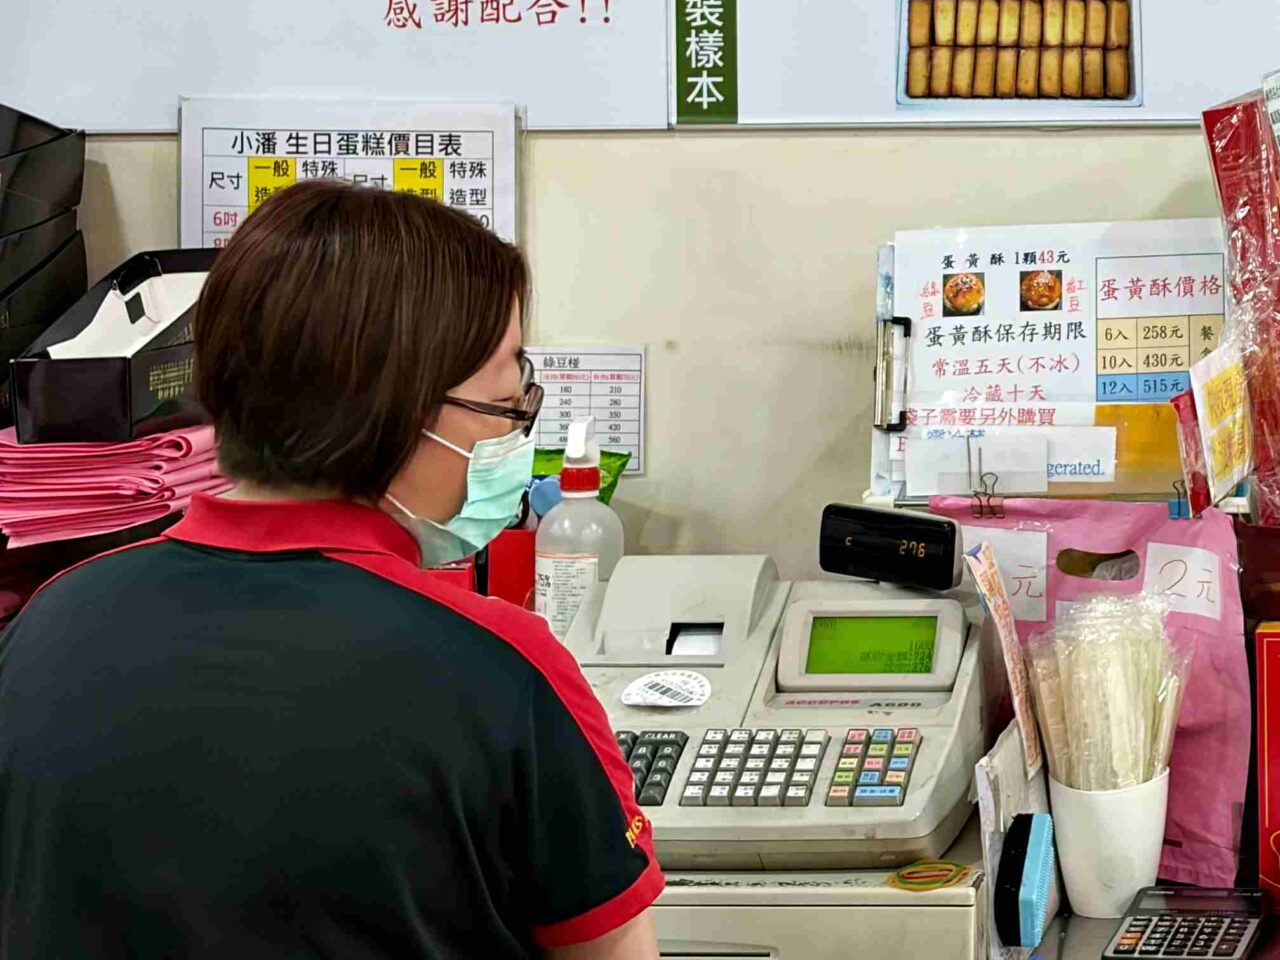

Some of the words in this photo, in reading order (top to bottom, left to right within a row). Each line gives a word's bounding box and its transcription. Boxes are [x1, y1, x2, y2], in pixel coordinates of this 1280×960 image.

[285, 131, 463, 157] 生日蛋糕價目表
[208, 172, 243, 191] 尺寸
[1098, 276, 1223, 301] 蛋黃酥價格
[925, 319, 1088, 348] 蛋黃酥保存期限
[1105, 327, 1130, 342] 6入
[1142, 324, 1184, 340] 258元
[932, 354, 1081, 377] 常溫五天(不冰)
[1101, 355, 1133, 370] 10入
[1142, 353, 1184, 368] 430元
[1101, 380, 1133, 396] 12入
[1143, 377, 1184, 393] 515元
[962, 385, 1047, 403] 冷藏十天
